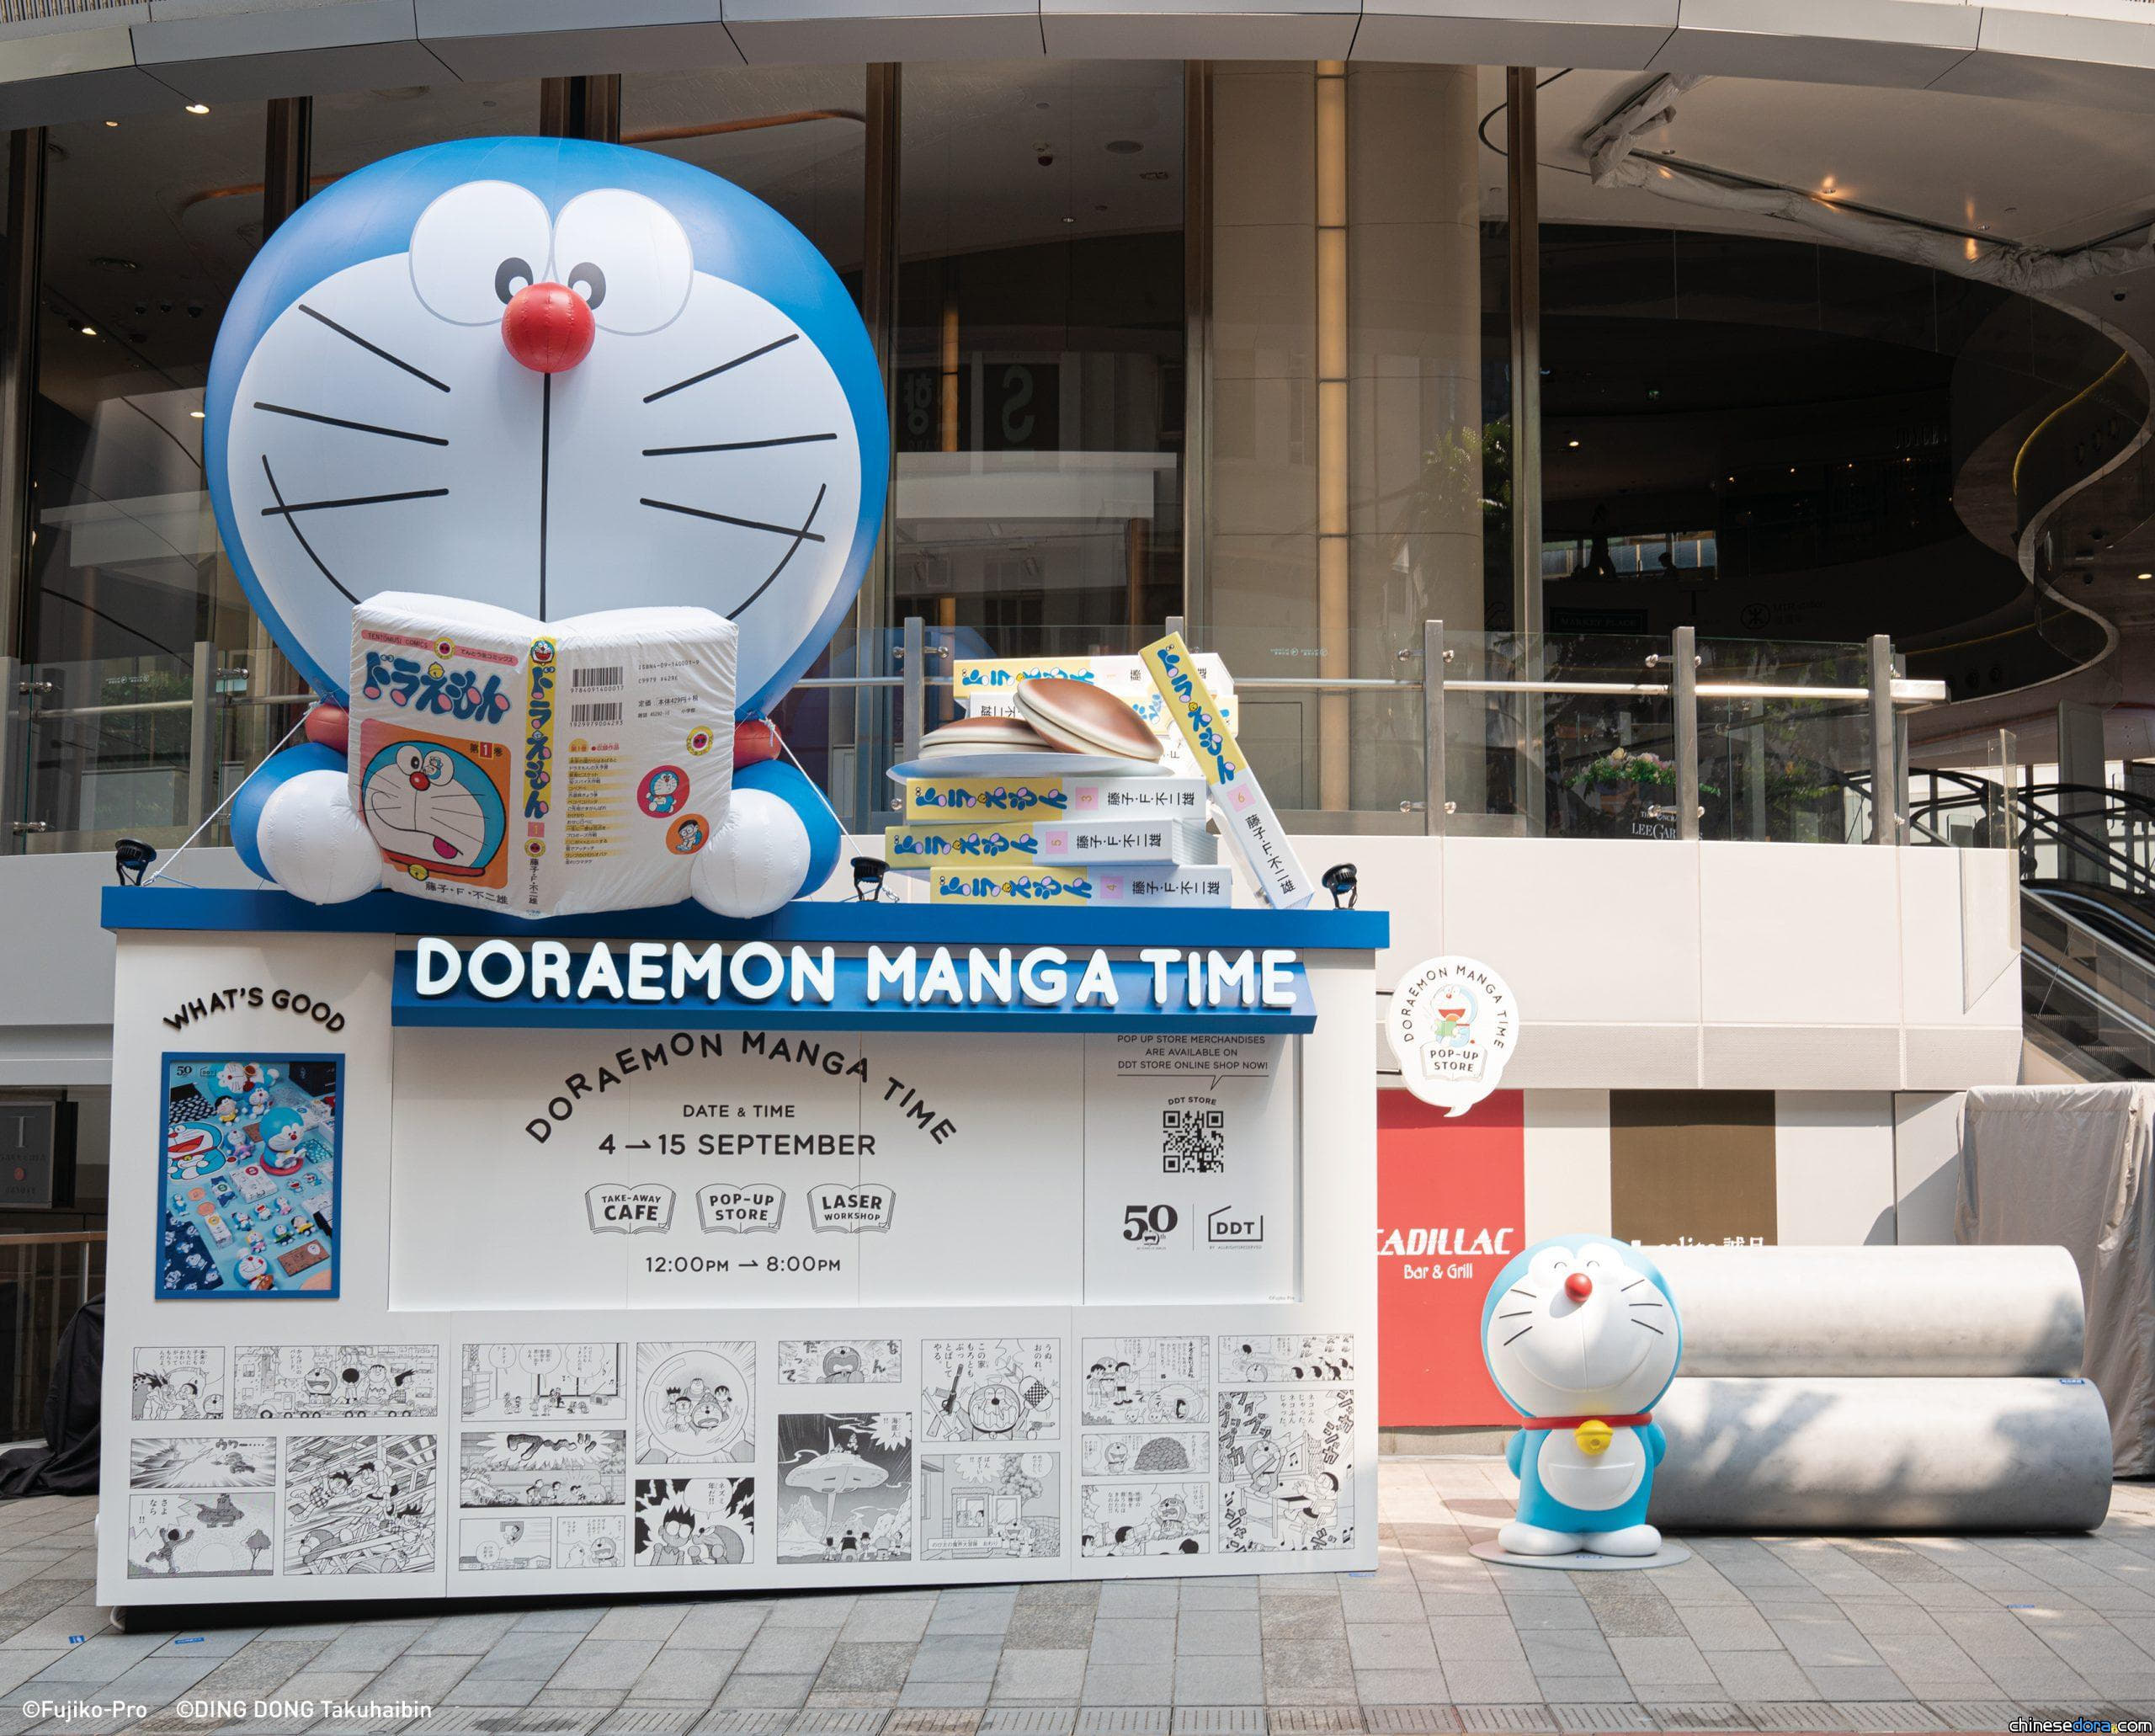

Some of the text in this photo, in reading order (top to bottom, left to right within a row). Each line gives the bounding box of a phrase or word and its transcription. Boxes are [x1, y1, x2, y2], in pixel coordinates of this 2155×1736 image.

[363, 652, 510, 724] ドラえもん
[1157, 643, 1236, 785] ドラえもん
[524, 665, 556, 819] ドラえもん
[915, 785, 1067, 811] ドラえもん
[894, 832, 1038, 857] ドラえもん
[939, 875, 1092, 899] ドラえもん
[416, 937, 1298, 1007] DORAEMON MANGA TIME
[162, 987, 346, 1032] WHAT'S GOOD
[1402, 965, 1508, 1049] DORAEMON MANGA TIME
[1117, 1035, 1266, 1044] POP UP STORE MERCHANDISES
[1145, 1048, 1237, 1057] ARE AVAILABLE ON
[1430, 1049, 1479, 1060] POP-UP
[1118, 1061, 1269, 1070] DDT STORE ONLINE SHOP NOW!
[1434, 1061, 1474, 1073] STORE
[525, 1030, 957, 1145] DORAEMON MANGA TIME
[1168, 1096, 1217, 1105] DDT STORE
[683, 1105, 795, 1118] DATE & TIME
[598, 1134, 876, 1156] 4 15 SEPTEMBER
[601, 1194, 662, 1204] TAKE-AWAY
[709, 1193, 774, 1207] POP-UP
[822, 1194, 883, 1211] LASER
[604, 1205, 659, 1222] CAFE
[715, 1207, 769, 1222] STORE
[824, 1212, 881, 1222] WORKSHOP
[1123, 1205, 1179, 1241] 50
[1216, 1222, 1255, 1236] DDT
[646, 1255, 842, 1273] 12:00PM 8:00PM
[1403, 1263, 1473, 1280] Bar & Grill
